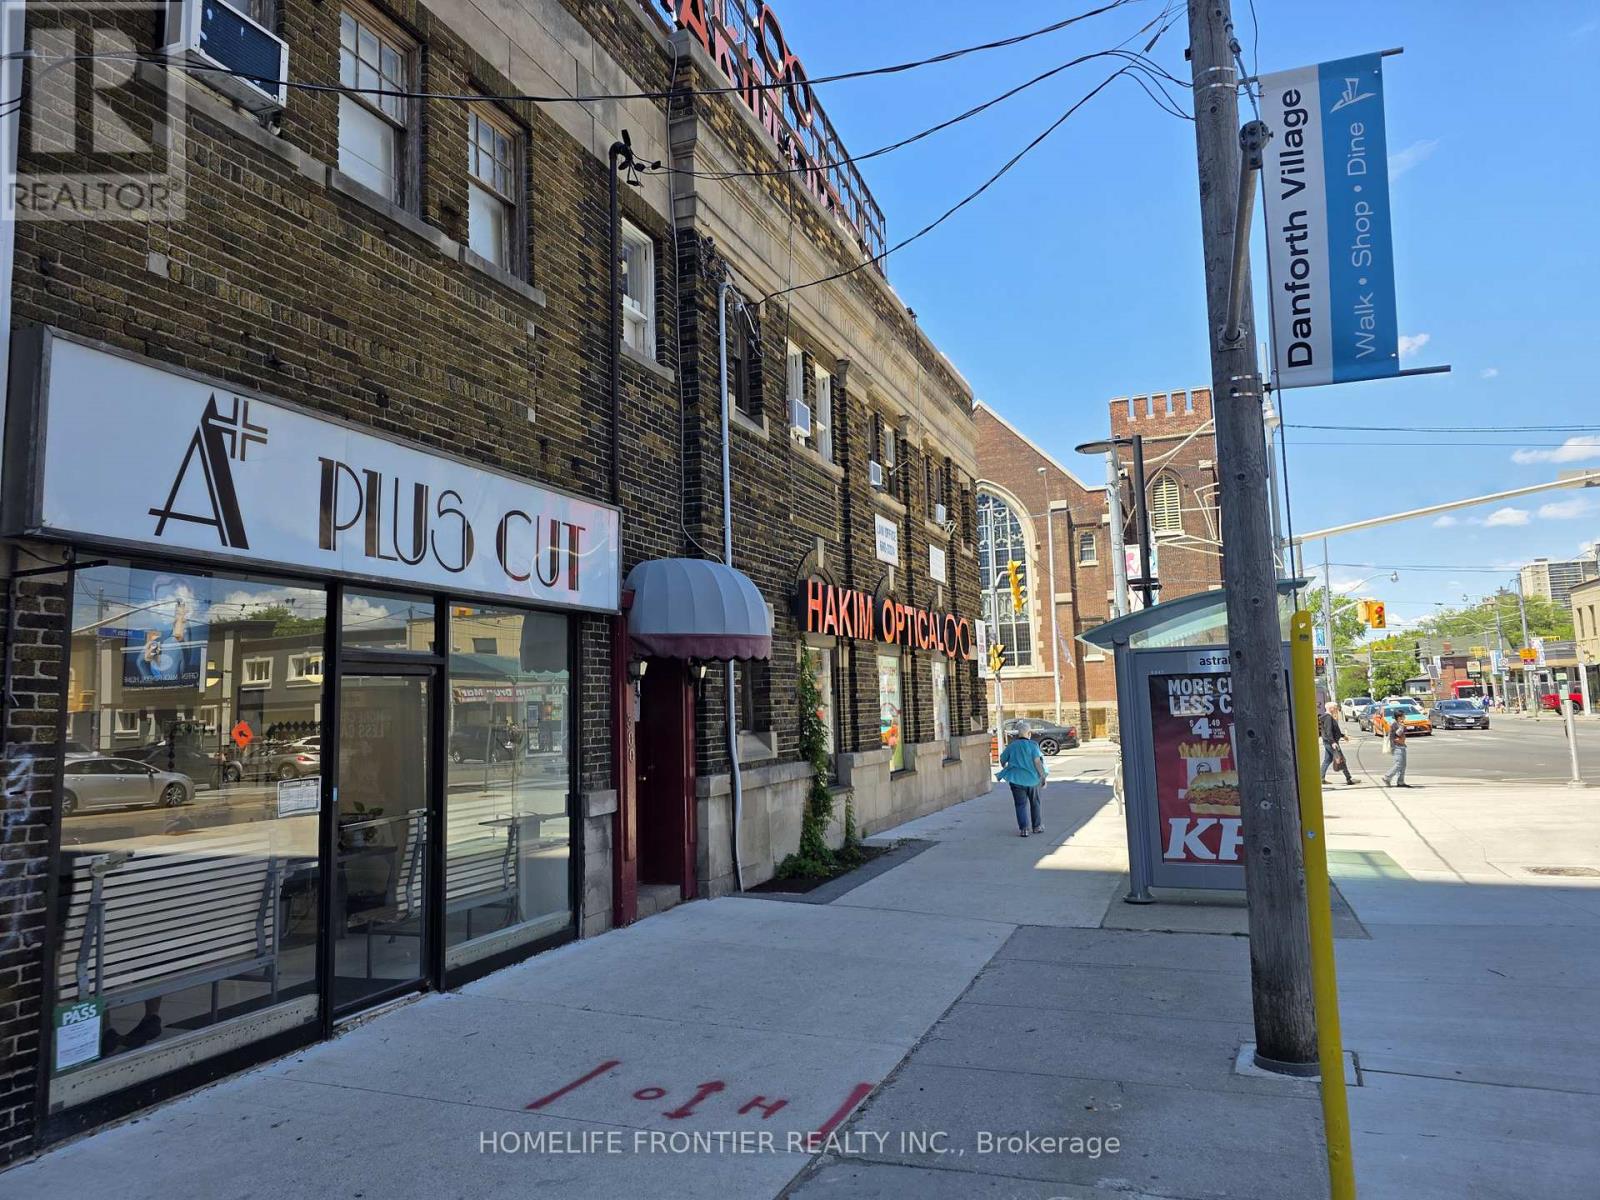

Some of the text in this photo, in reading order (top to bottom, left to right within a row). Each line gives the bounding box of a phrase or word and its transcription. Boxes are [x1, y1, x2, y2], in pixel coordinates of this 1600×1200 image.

[1279, 88, 1313, 368] Danforth Village
[1347, 121, 1376, 359] Walk Shop Dine
[318, 456, 475, 573] PLUS
[495, 510, 586, 591] CUT
[807, 579, 873, 641] HAKIM
[882, 598, 944, 651] OPTICAL
[1168, 678, 1213, 696] MORE
[1169, 694, 1215, 716] LESS
[62, 1004, 97, 1026] PASS
